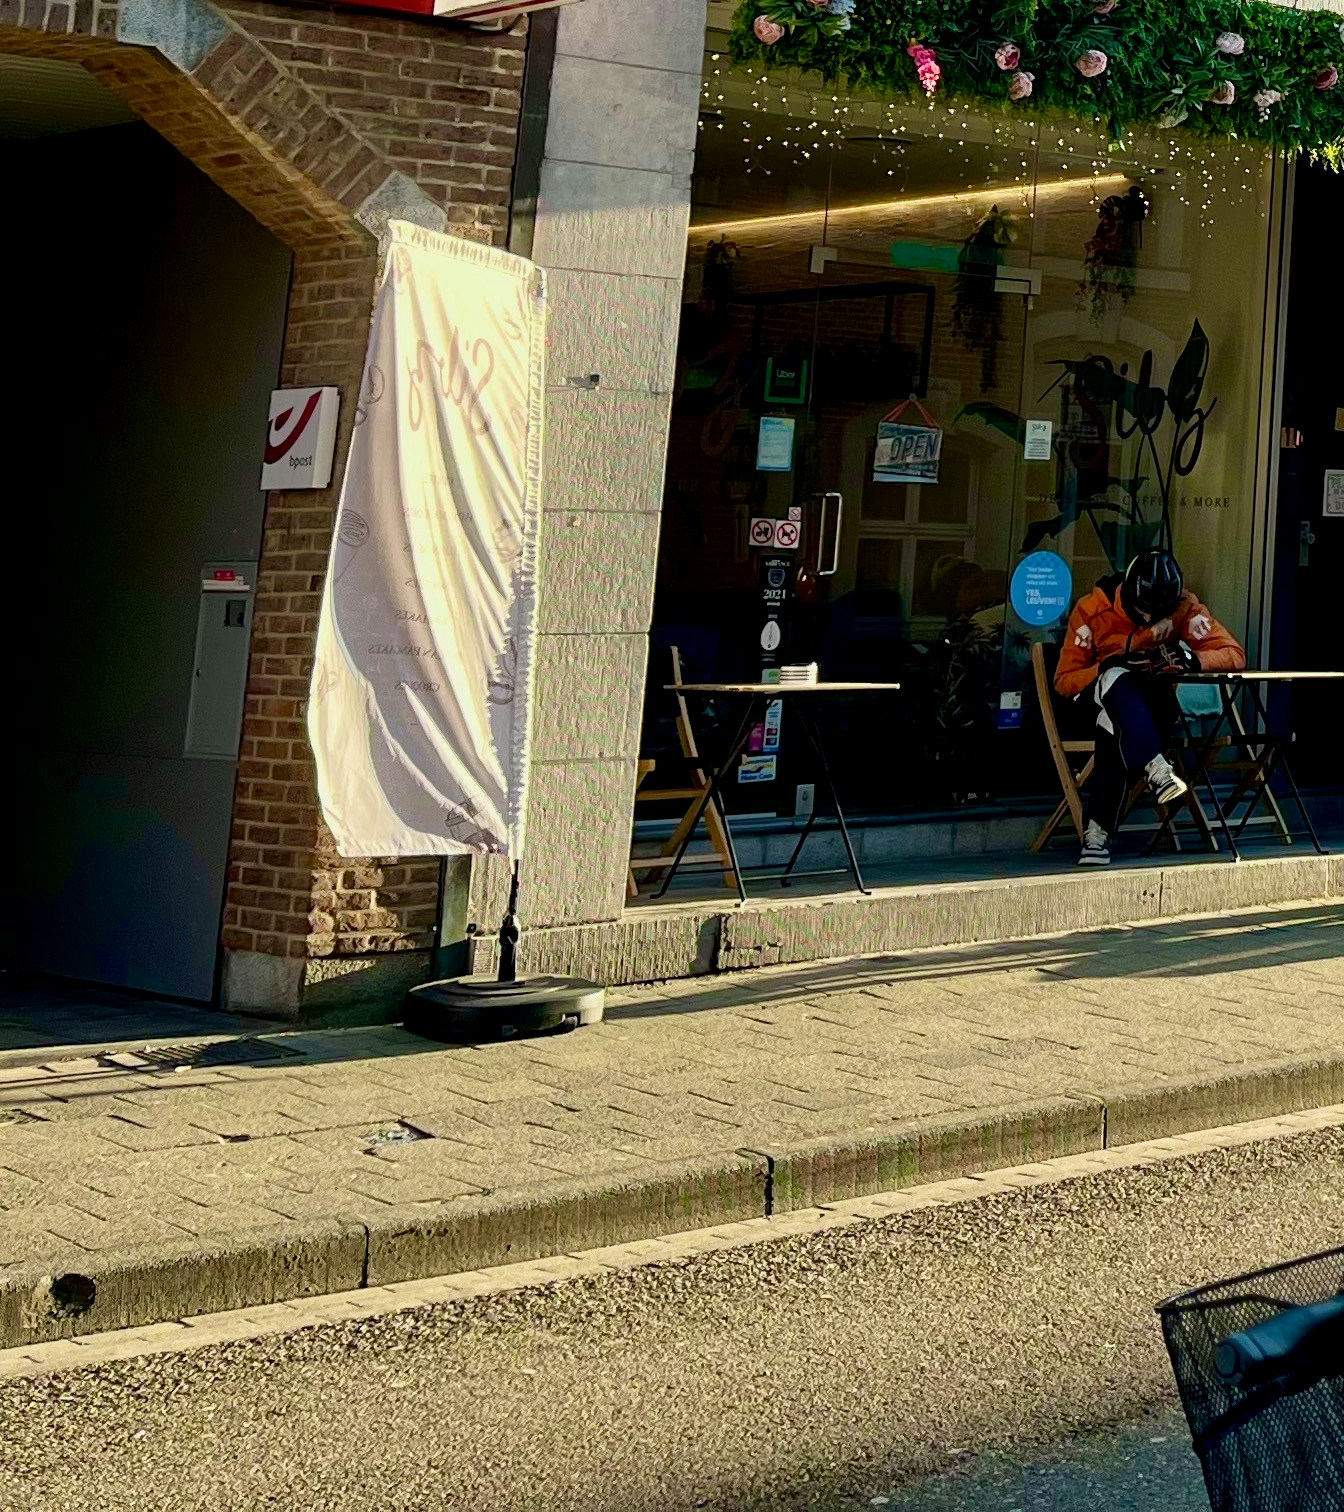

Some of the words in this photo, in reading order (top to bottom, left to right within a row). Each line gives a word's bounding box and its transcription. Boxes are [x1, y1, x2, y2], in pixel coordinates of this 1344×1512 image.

[889, 433, 938, 462] OPEN
[289, 454, 313, 470] bpost
[1193, 496, 1231, 508] MORE
[763, 589, 786, 600] 2021
